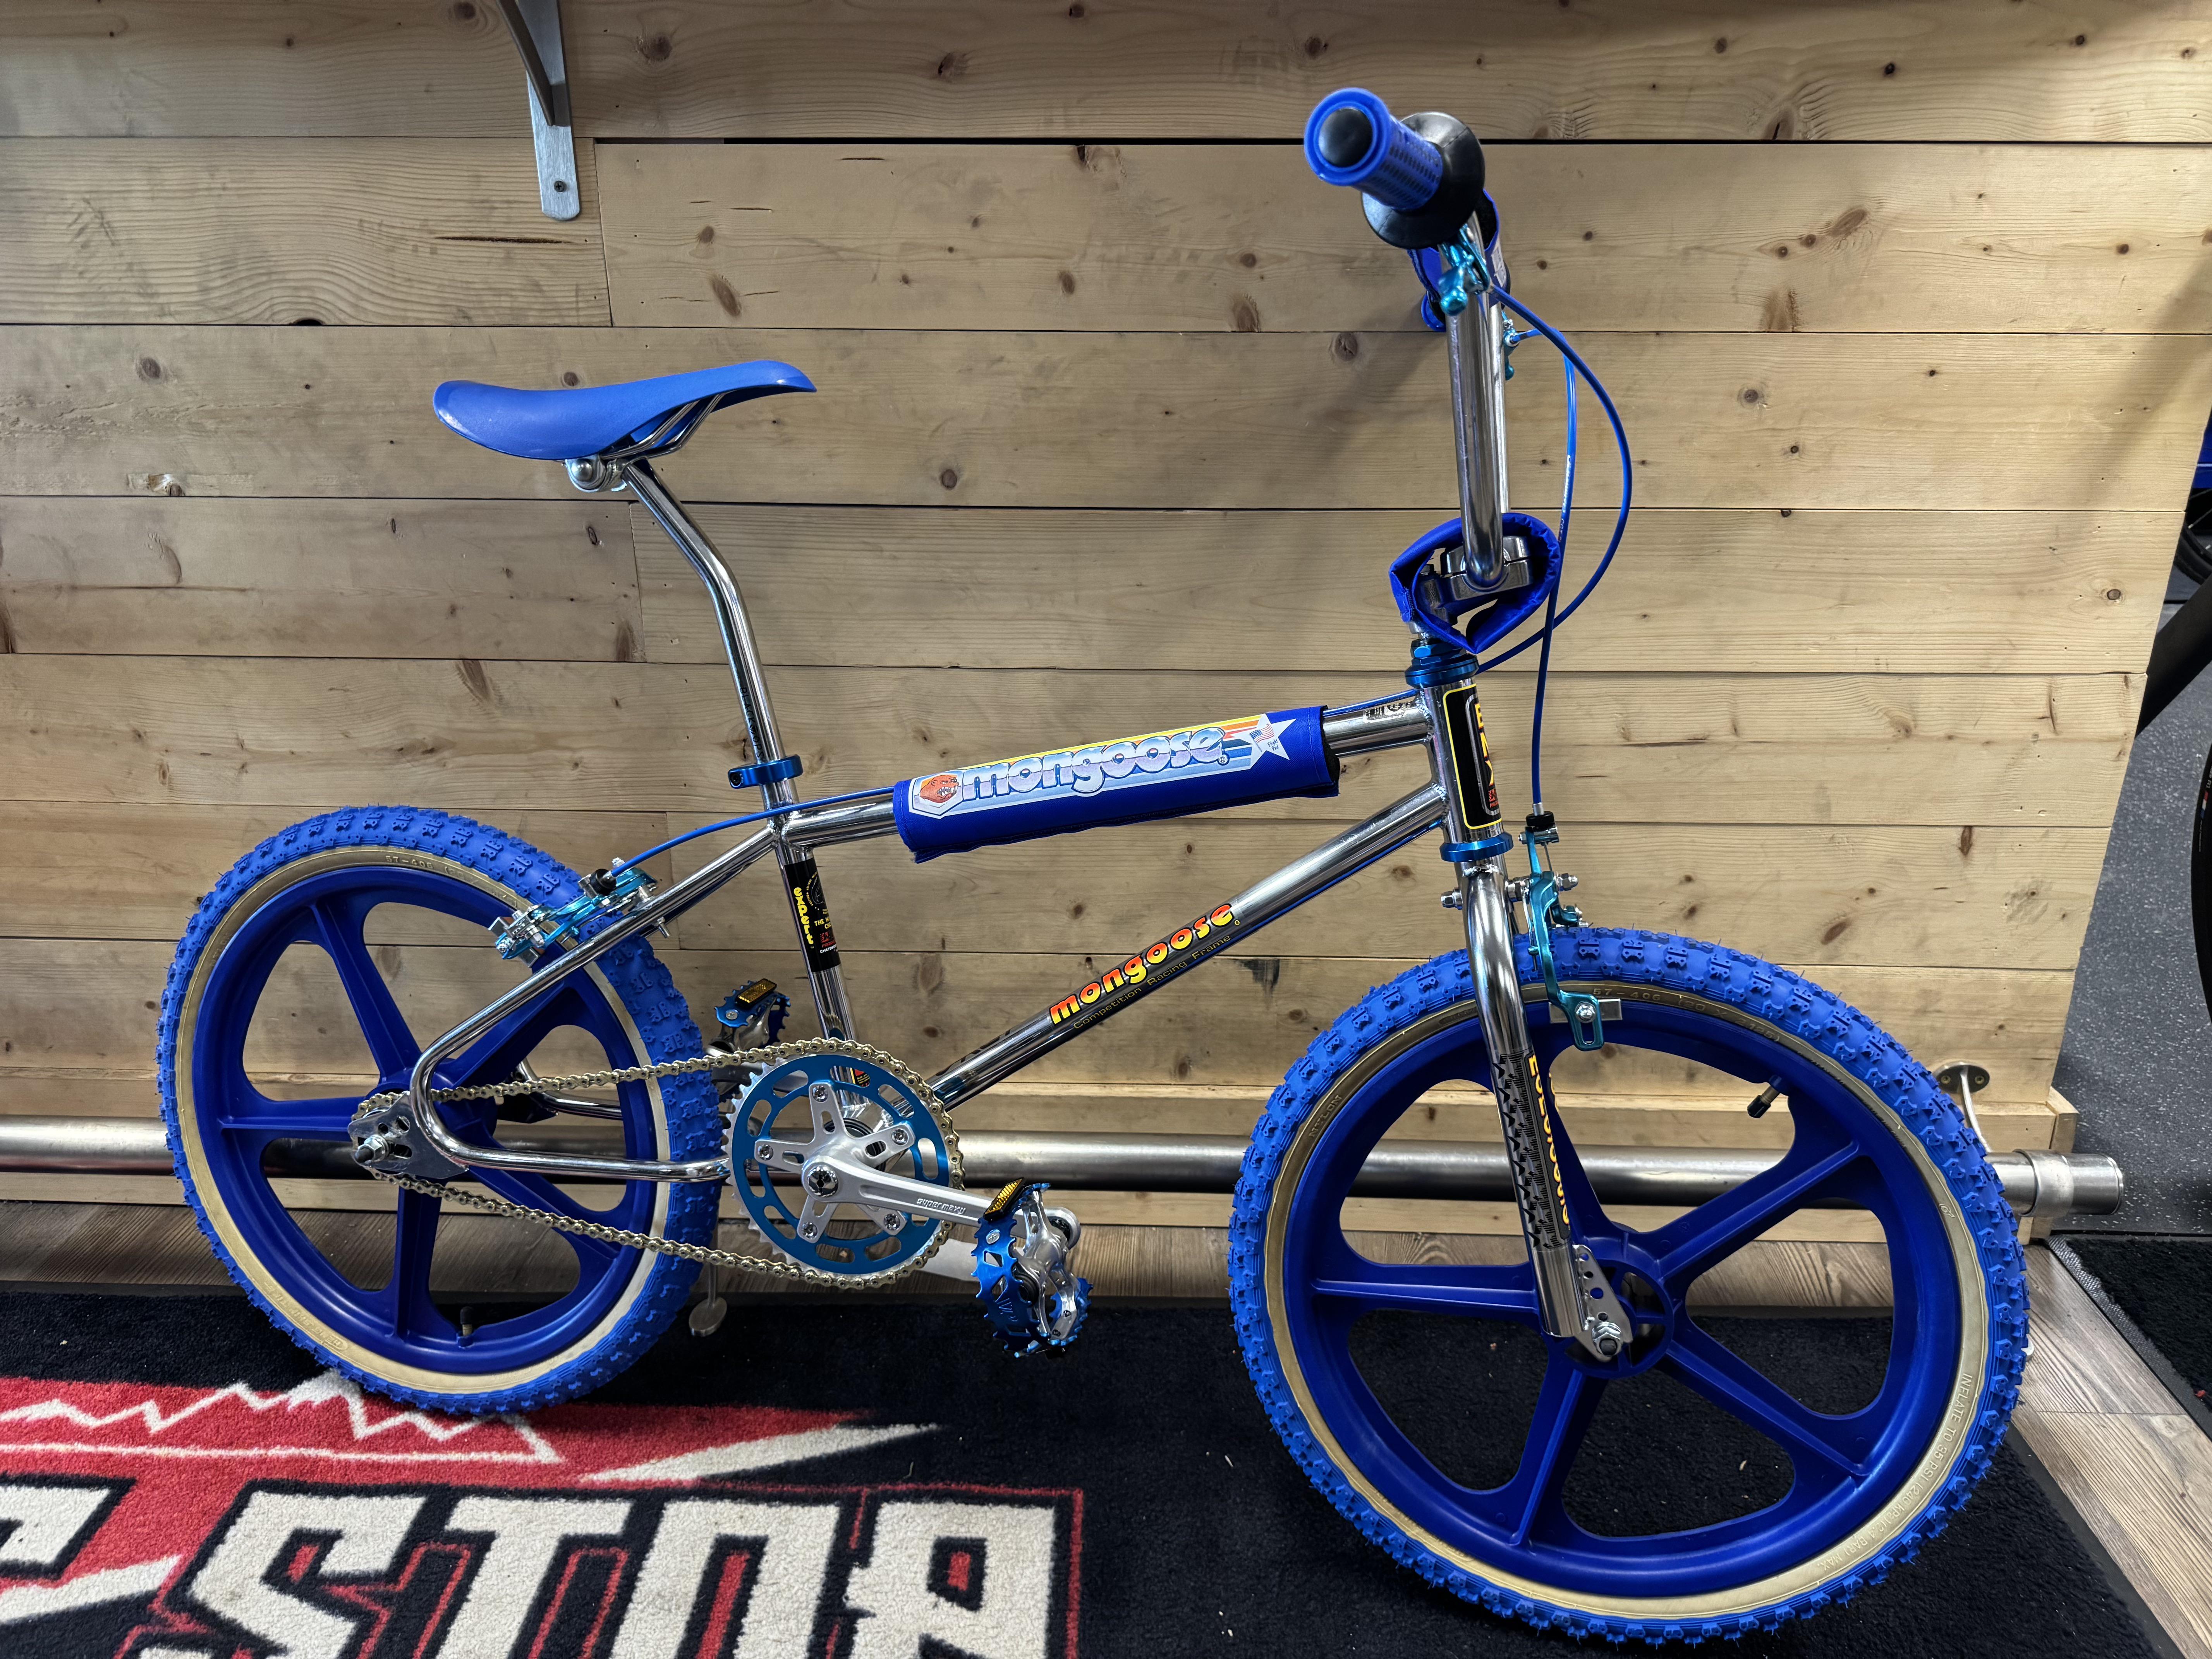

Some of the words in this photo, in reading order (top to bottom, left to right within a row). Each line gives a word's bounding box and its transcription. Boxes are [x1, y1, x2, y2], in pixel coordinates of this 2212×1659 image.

[740, 687, 756, 723] BLACK
[752, 737, 764, 758] OPS
[793, 887, 814, 944] expert
[814, 918, 824, 926] THE
[1049, 903, 1233, 1025] mongoose
[1073, 987, 1142, 1029] Competition
[1146, 960, 1188, 986] Racing
[1191, 935, 1231, 960] Frame
[1309, 1094, 1343, 1138] NYLON
[1951, 1372, 1973, 1423] INFLATE
[1934, 1444, 1948, 1461] 35
[1942, 1427, 1957, 1442] TO
[1902, 1482, 1924, 1506] (240
[1843, 1536, 1868, 1556] BAR)
